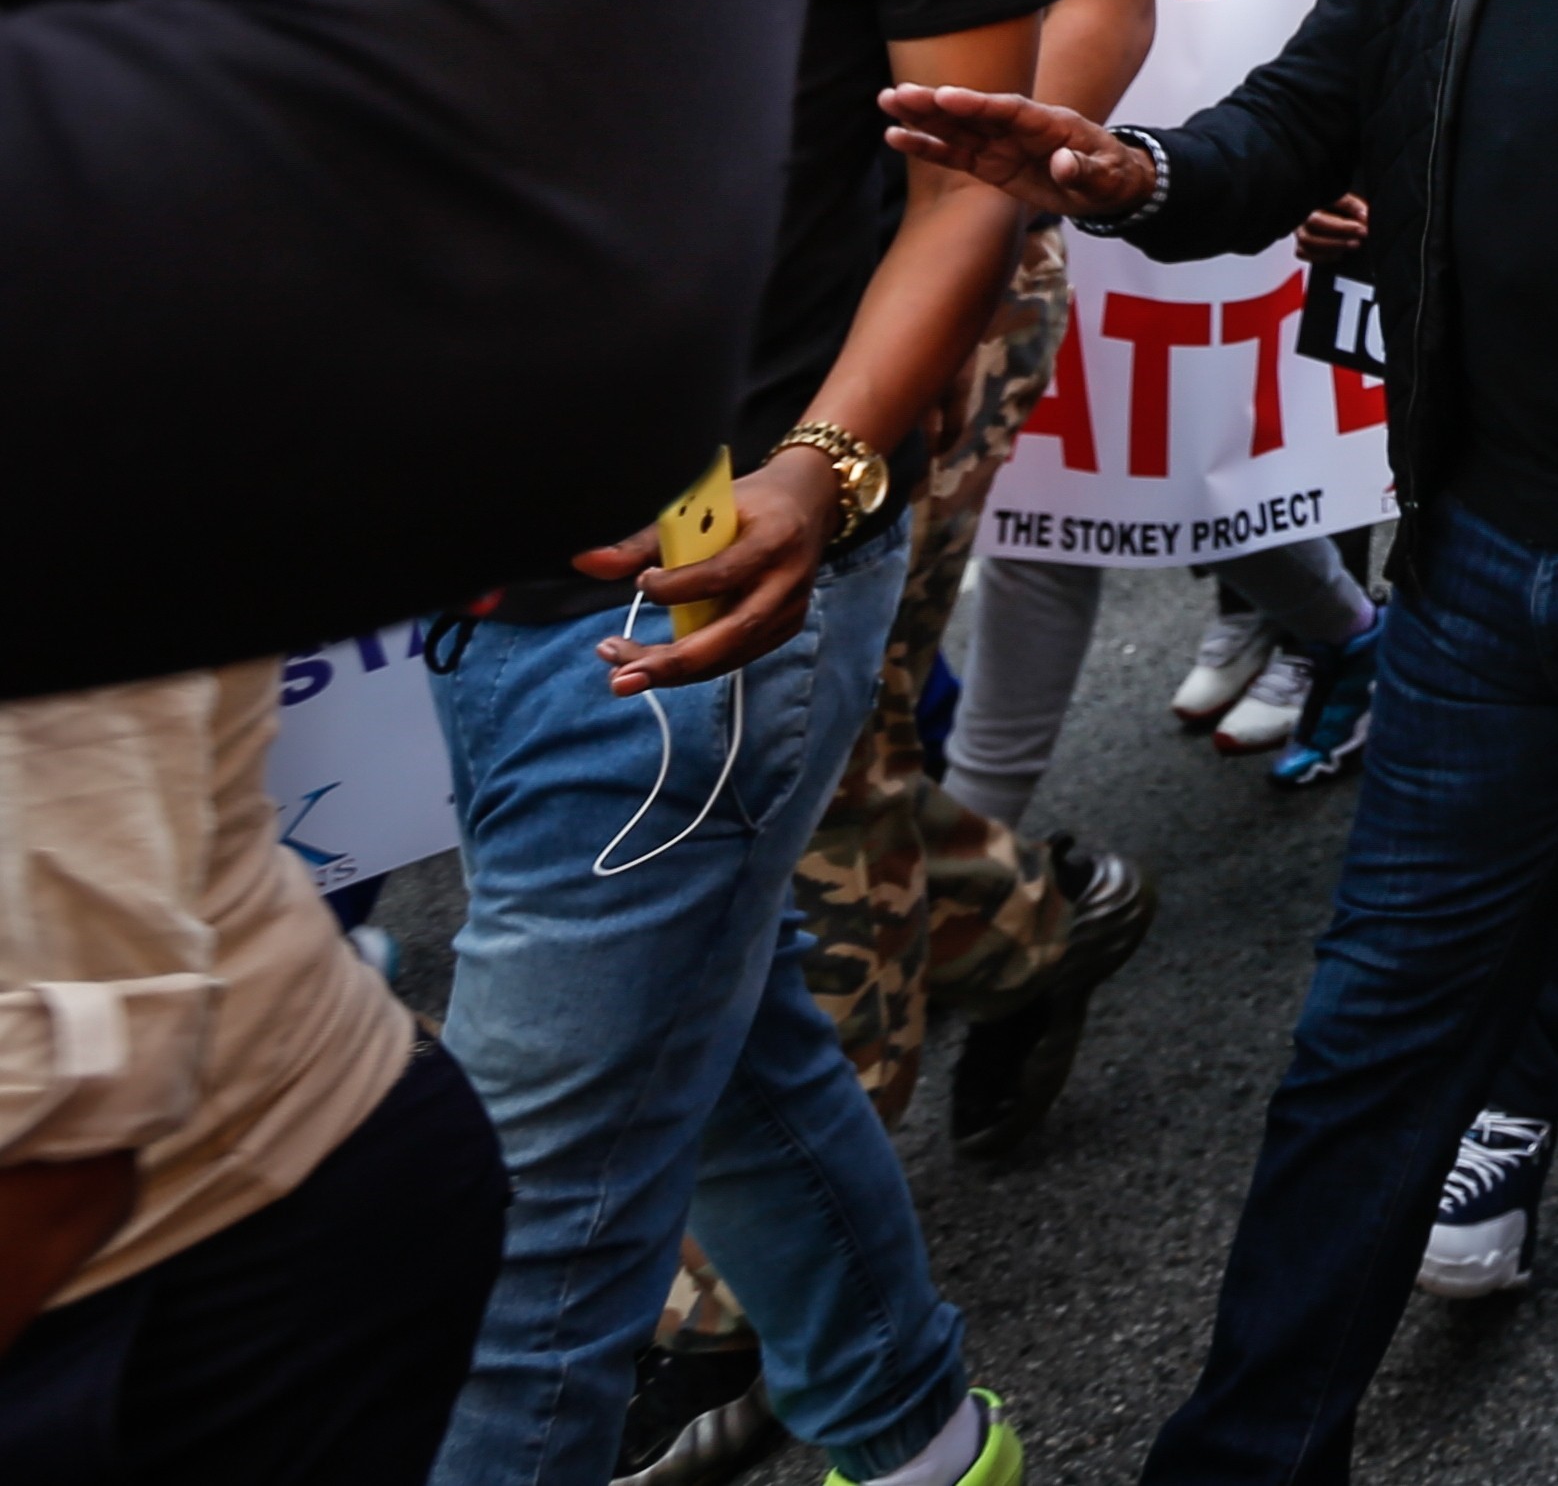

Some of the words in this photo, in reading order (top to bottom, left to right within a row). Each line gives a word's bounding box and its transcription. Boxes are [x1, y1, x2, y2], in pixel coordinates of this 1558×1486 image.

[994, 510, 1052, 548] THE
[1059, 517, 1182, 557] STOKEY
[1191, 488, 1324, 552] PROJECT
